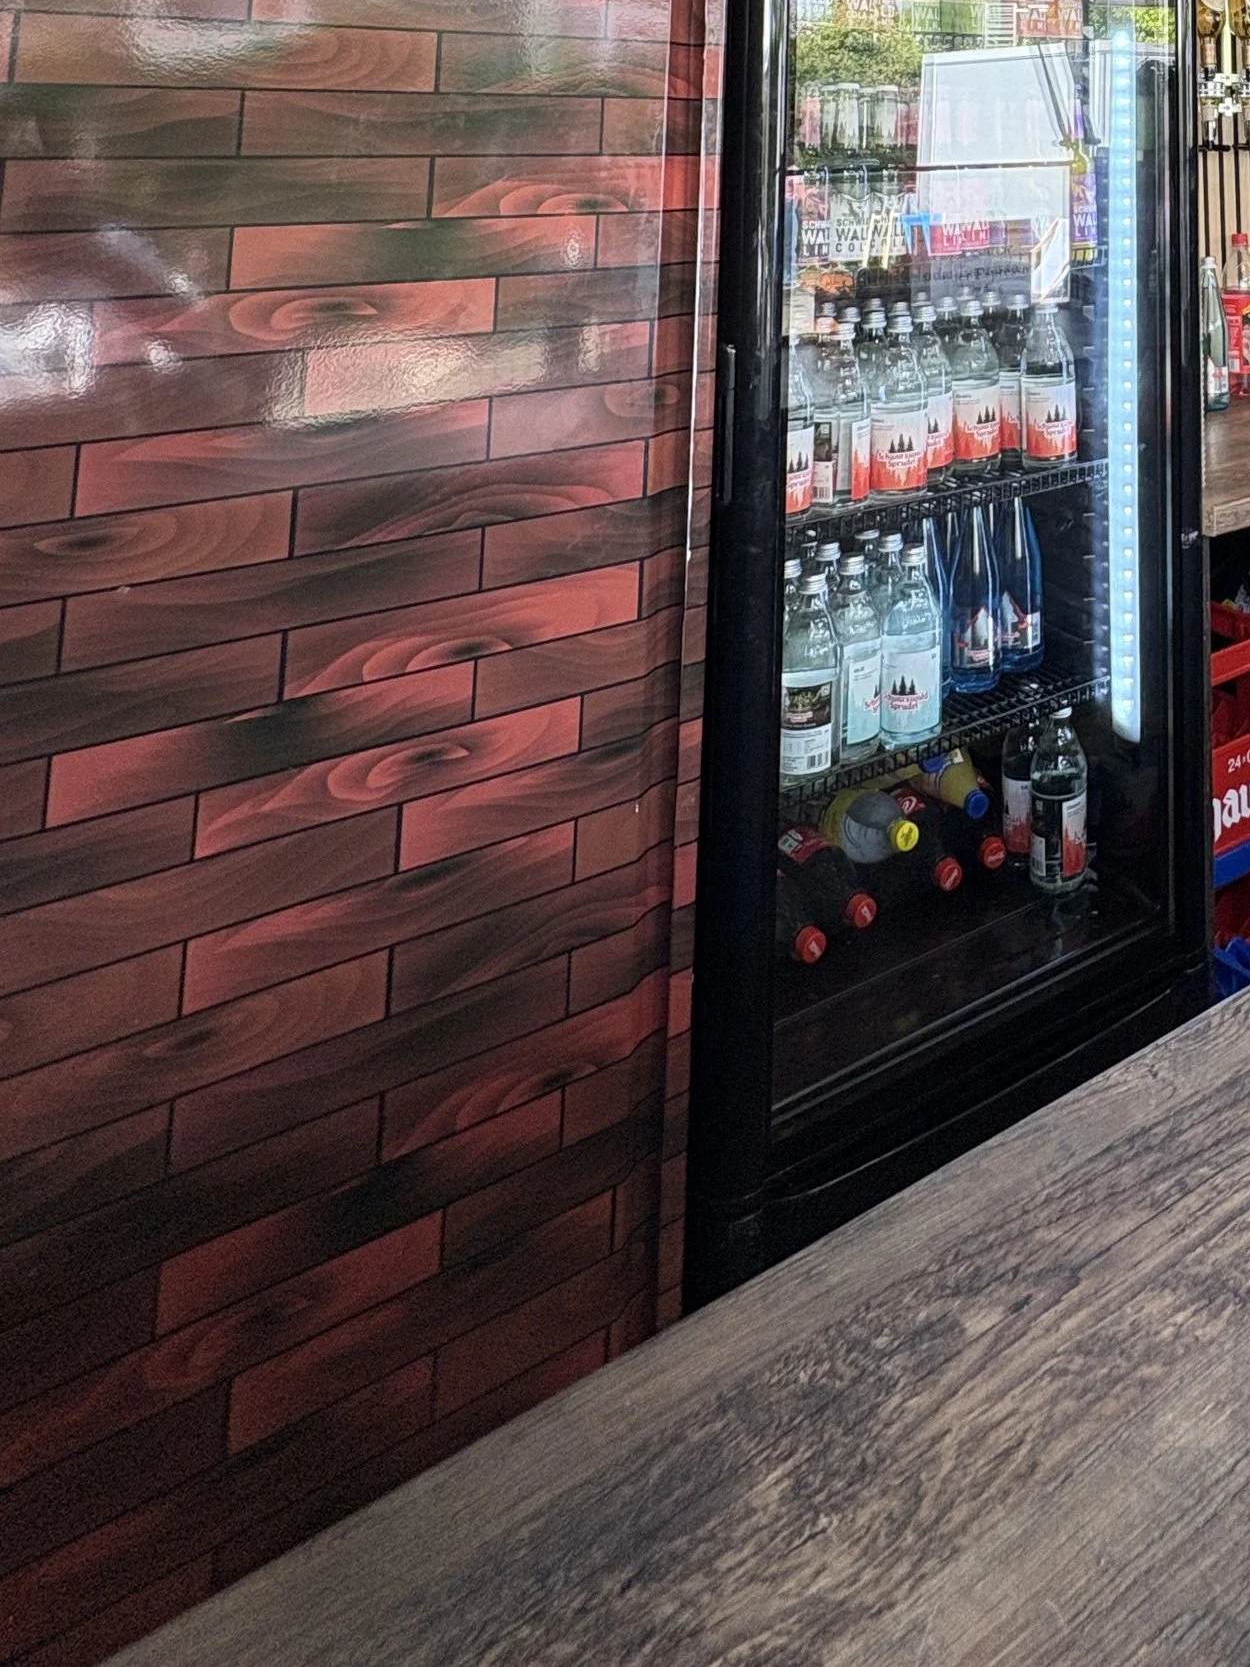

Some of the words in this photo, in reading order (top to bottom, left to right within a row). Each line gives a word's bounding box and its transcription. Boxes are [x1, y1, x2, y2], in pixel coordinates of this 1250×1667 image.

[1072, 214, 1098, 227] WAL
[801, 228, 830, 245] WAL
[835, 227, 869, 242] WAL
[835, 242, 867, 253] COL
